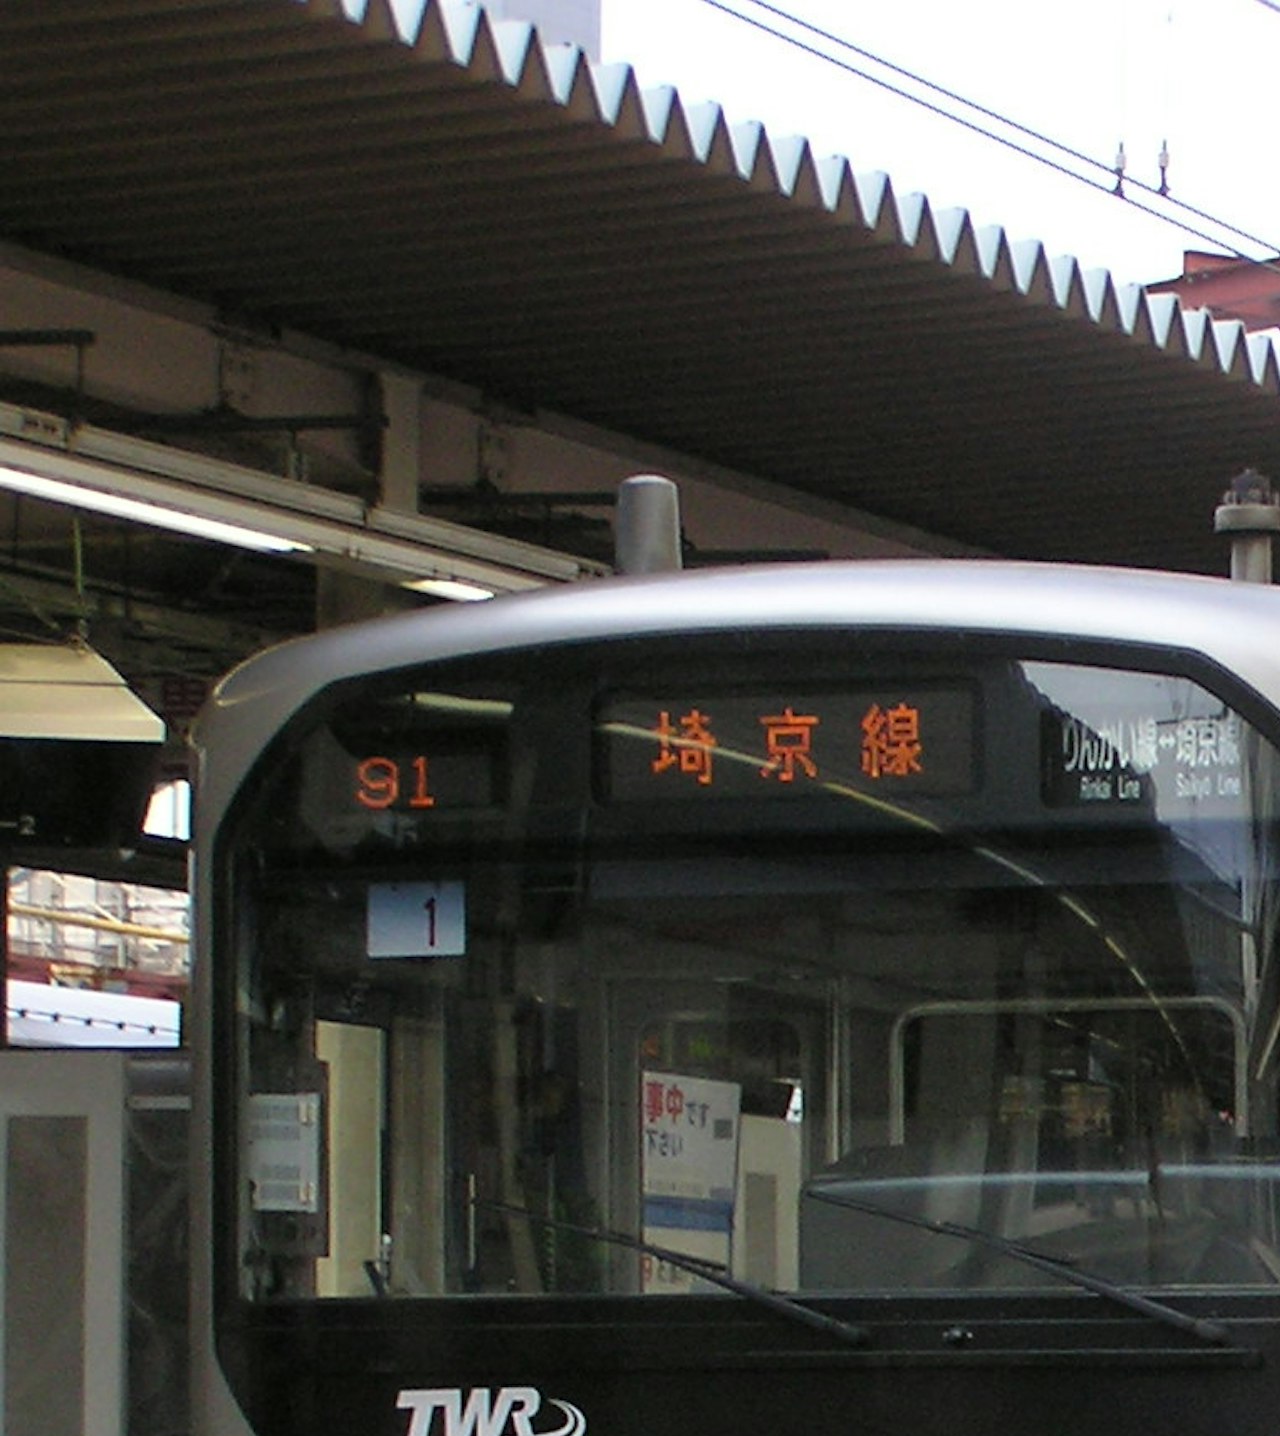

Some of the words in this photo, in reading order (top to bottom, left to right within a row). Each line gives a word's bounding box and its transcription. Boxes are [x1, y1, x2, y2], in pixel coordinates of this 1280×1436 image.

[651, 702, 923, 785] 埼京線
[355, 756, 436, 811] 91
[1118, 773, 1141, 800] Line
[1217, 772, 1241, 797] Line
[423, 896, 437, 948] 1
